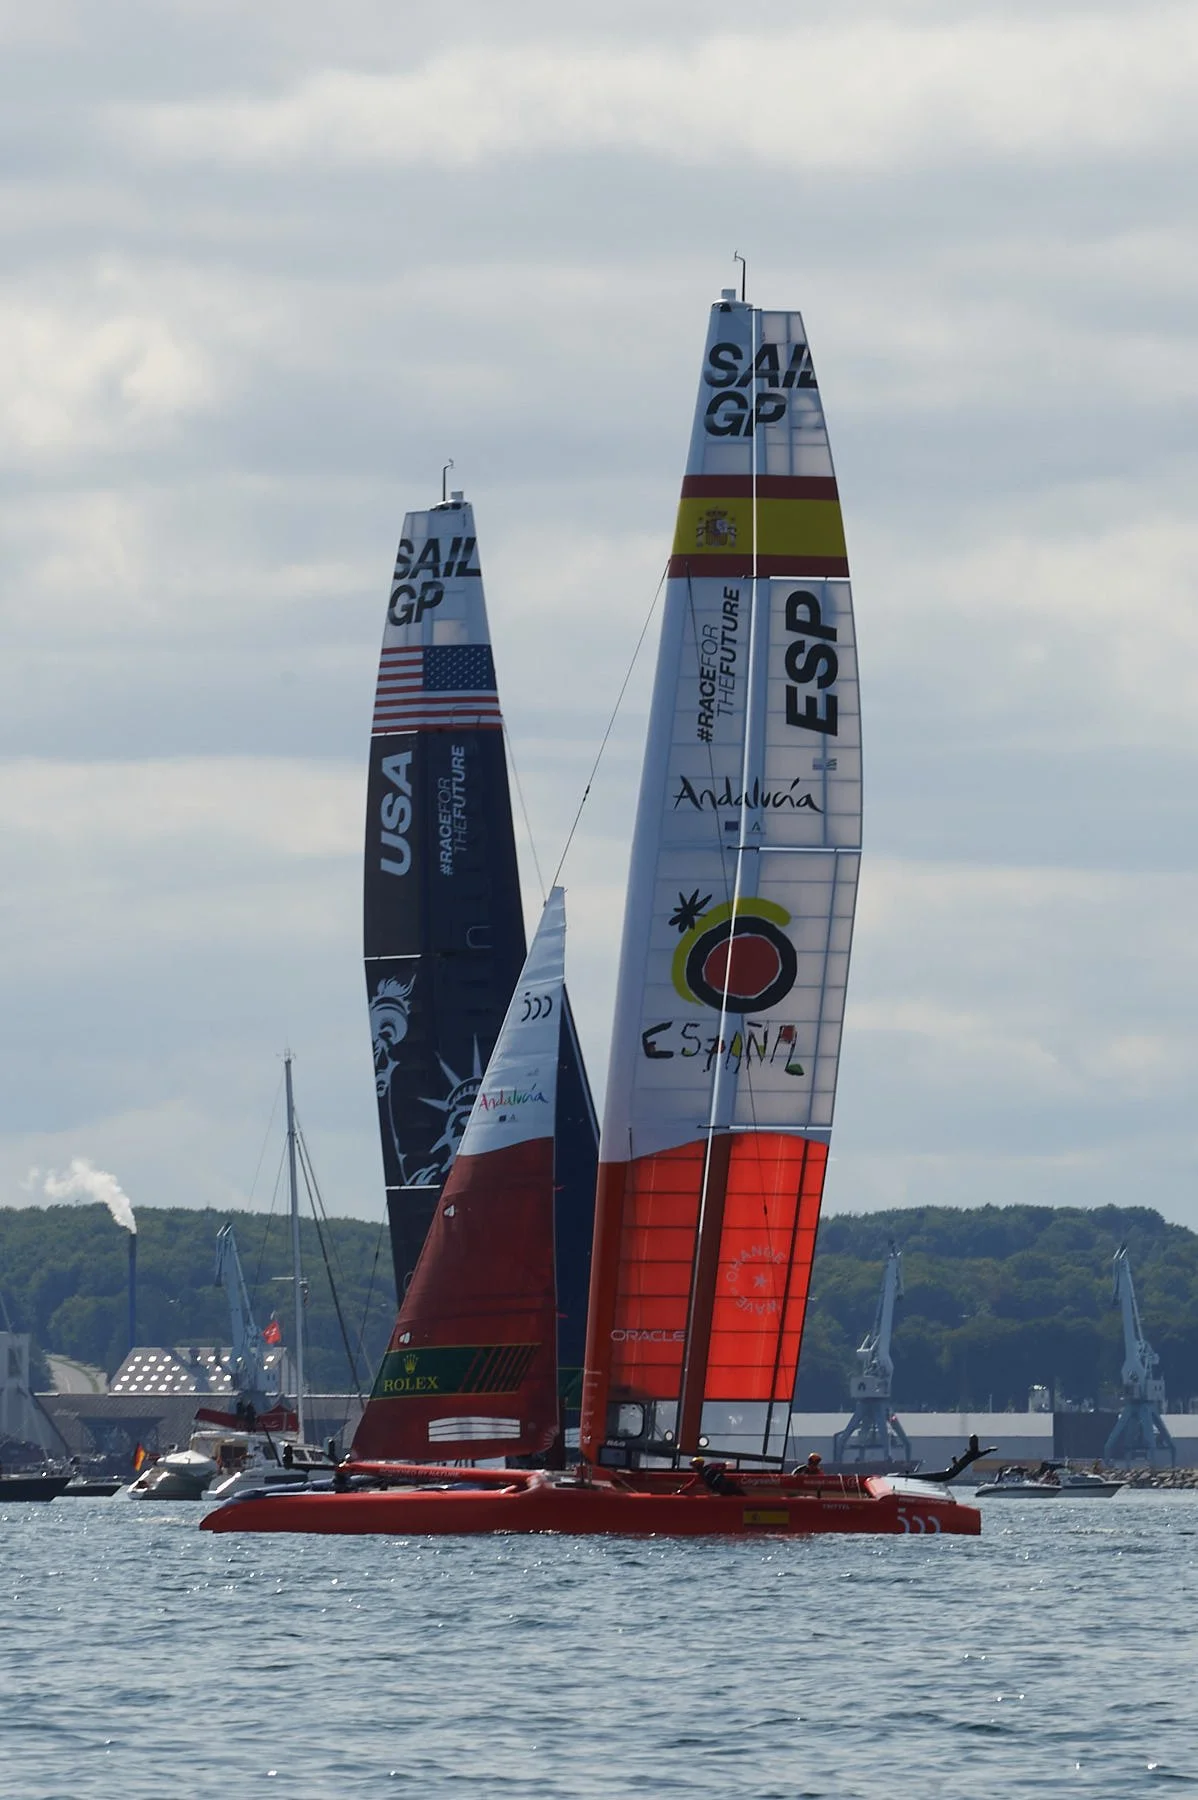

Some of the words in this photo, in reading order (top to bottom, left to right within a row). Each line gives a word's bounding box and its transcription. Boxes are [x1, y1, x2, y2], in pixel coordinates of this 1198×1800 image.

[704, 343, 818, 388] SAIL
[704, 391, 786, 436] GP
[393, 537, 481, 580] SAIL
[388, 581, 445, 626] GP
[717, 586, 739, 716] THEFUTURE
[785, 590, 838, 736] ESP
[697, 623, 718, 743] #RACEFOR
[380, 751, 412, 876] USA
[452, 745, 468, 852] THEFUTURE
[673, 775, 825, 814] Andalucía
[438, 777, 453, 876] #RACEFOR
[642, 1021, 804, 1076] ESPAÑA
[611, 1329, 685, 1342] ORACLE
[384, 1376, 439, 1392] ROLEX
